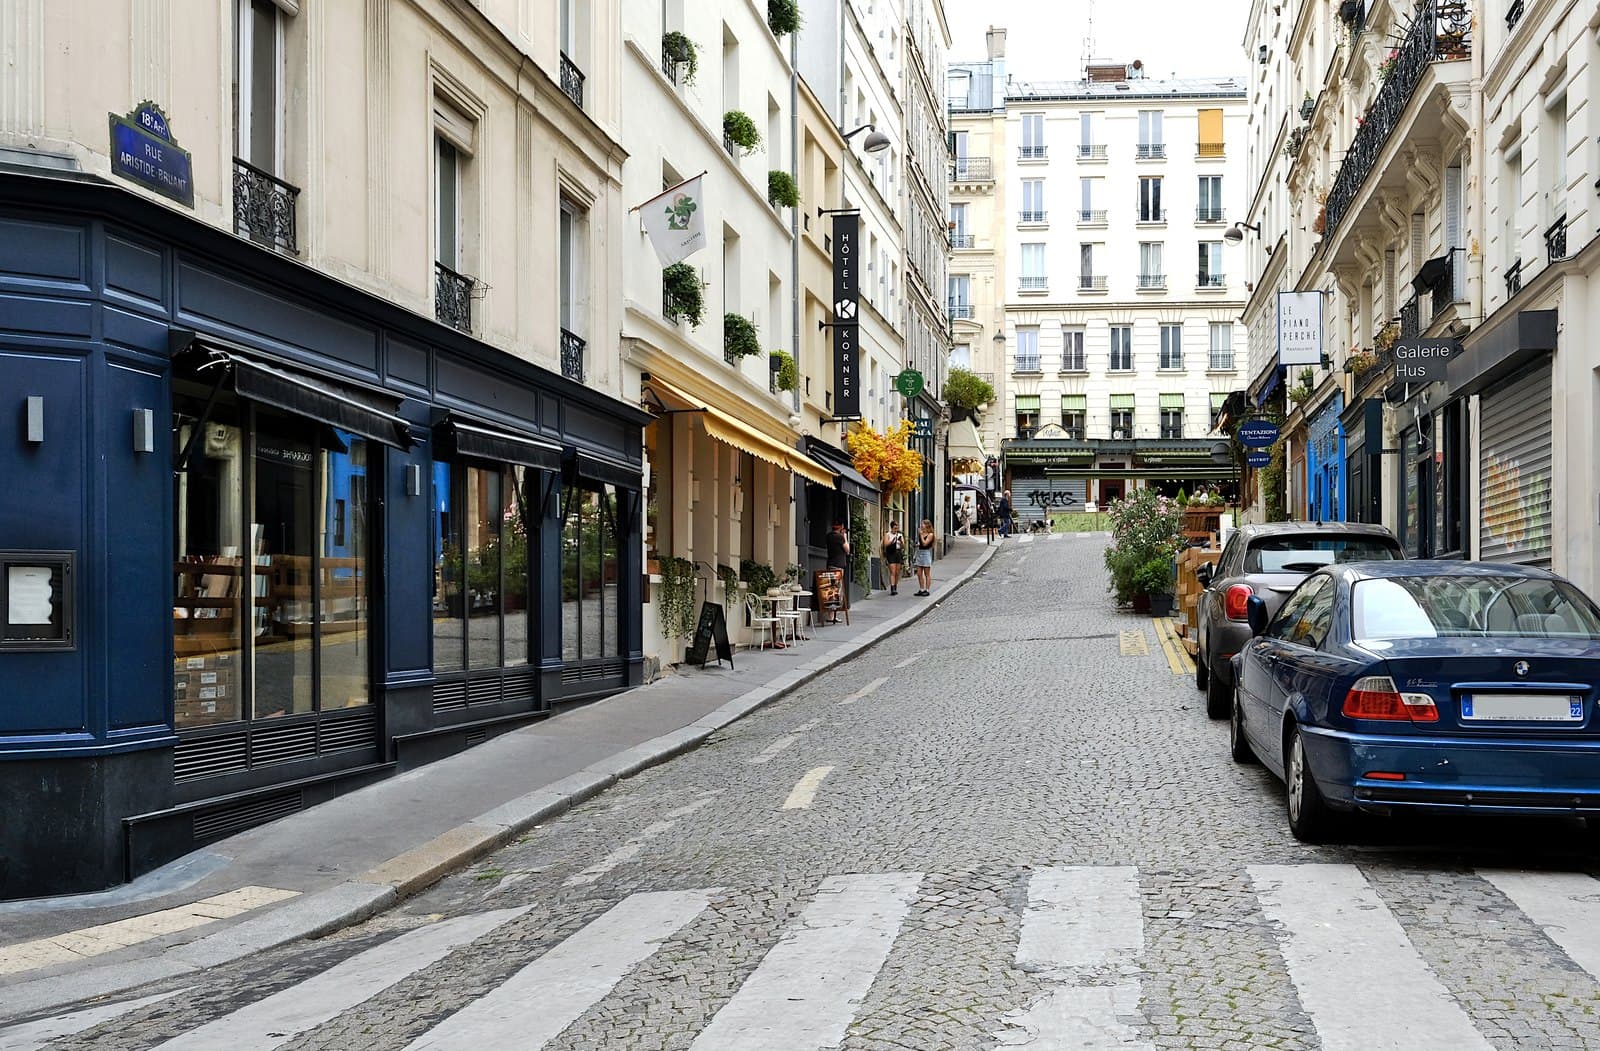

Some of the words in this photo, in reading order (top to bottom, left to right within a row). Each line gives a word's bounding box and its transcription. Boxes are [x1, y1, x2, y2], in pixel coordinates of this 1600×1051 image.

[145, 143, 163, 162] RUE
[841, 234, 849, 290] HÔTEL
[1283, 305, 1291, 315] LE
[1283, 318, 1309, 328] PIANO
[1283, 330, 1316, 341] PERCHÉ
[1396, 343, 1450, 359] Galerie
[842, 329, 850, 398] KORNER
[1396, 364, 1426, 377] Hus
[1570, 707, 1581, 716] 22
